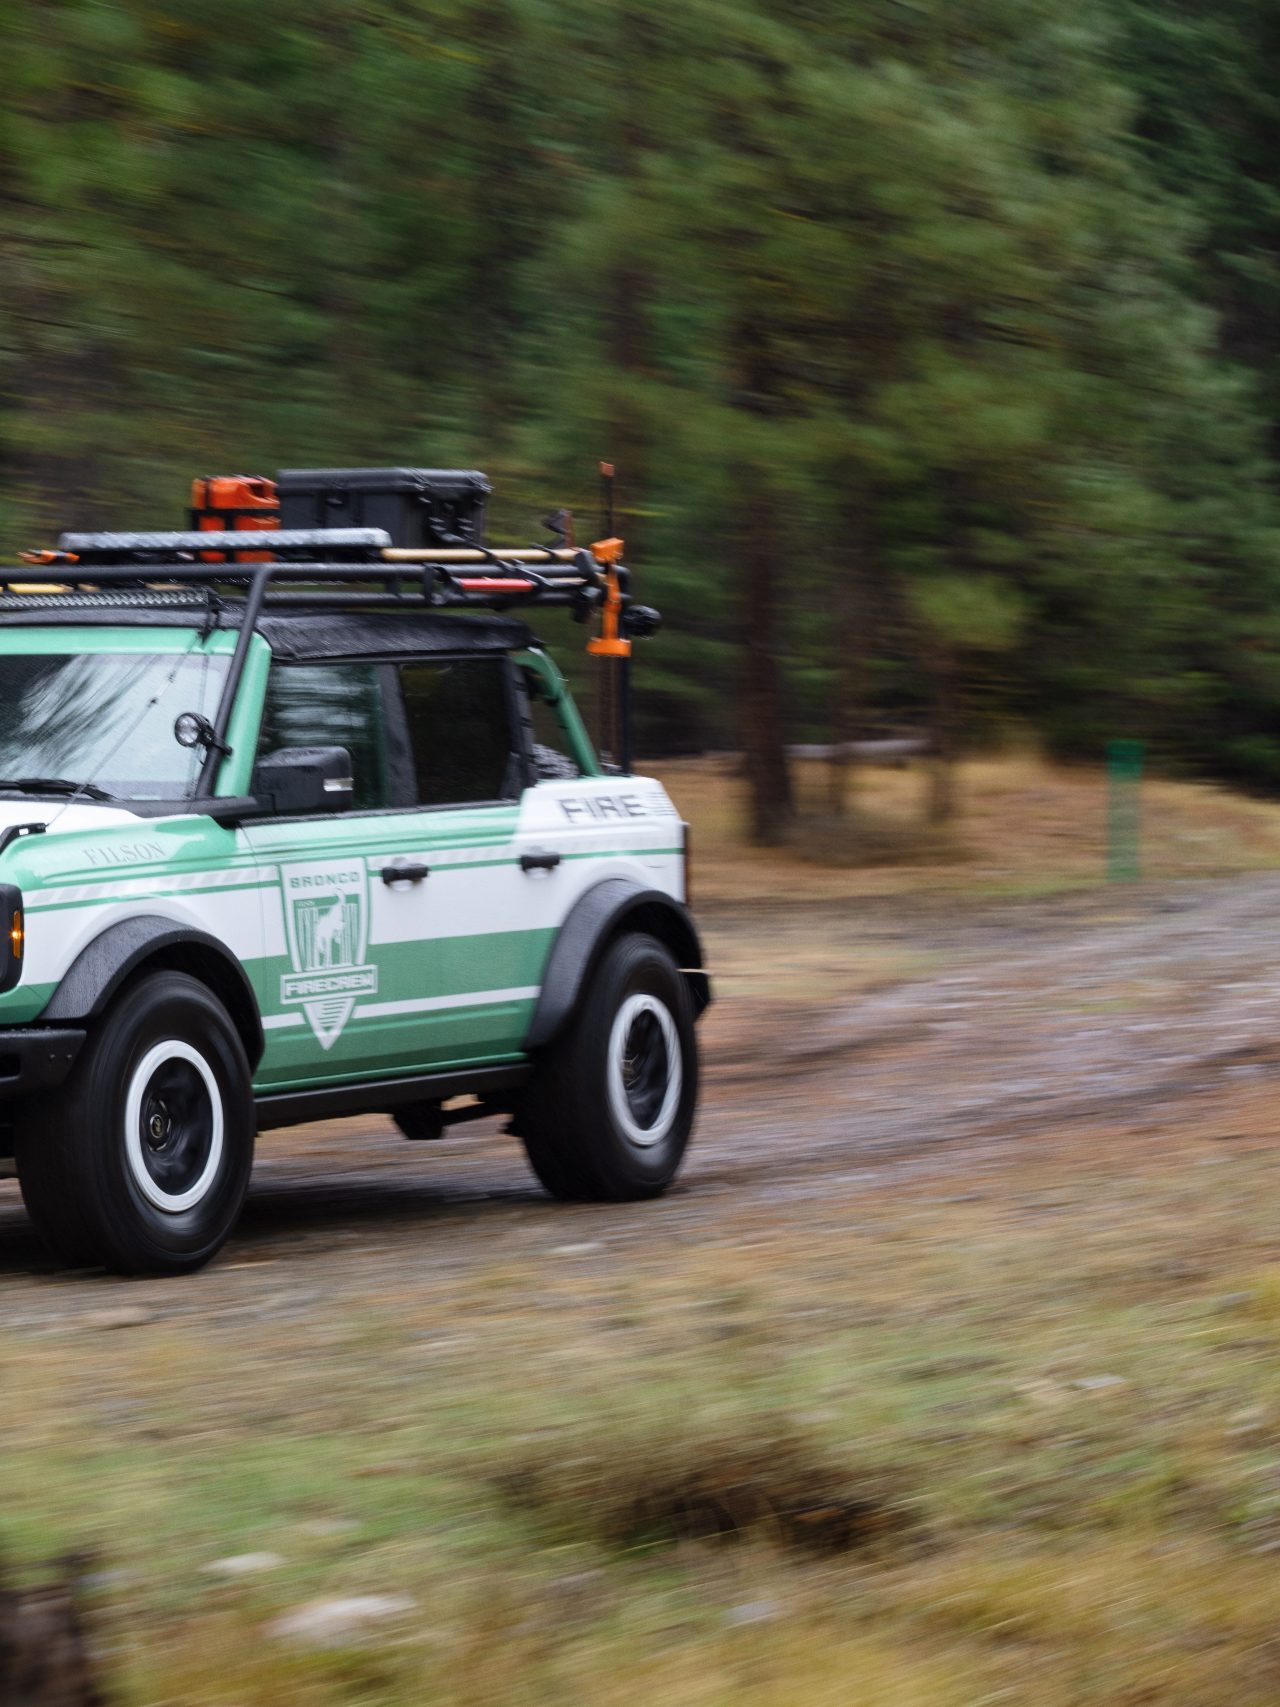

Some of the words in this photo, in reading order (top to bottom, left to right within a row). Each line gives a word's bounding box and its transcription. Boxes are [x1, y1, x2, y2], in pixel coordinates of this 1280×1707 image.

[557, 794, 646, 823] FIRE
[83, 841, 166, 865] FILSON
[289, 871, 360, 888] BRONCO
